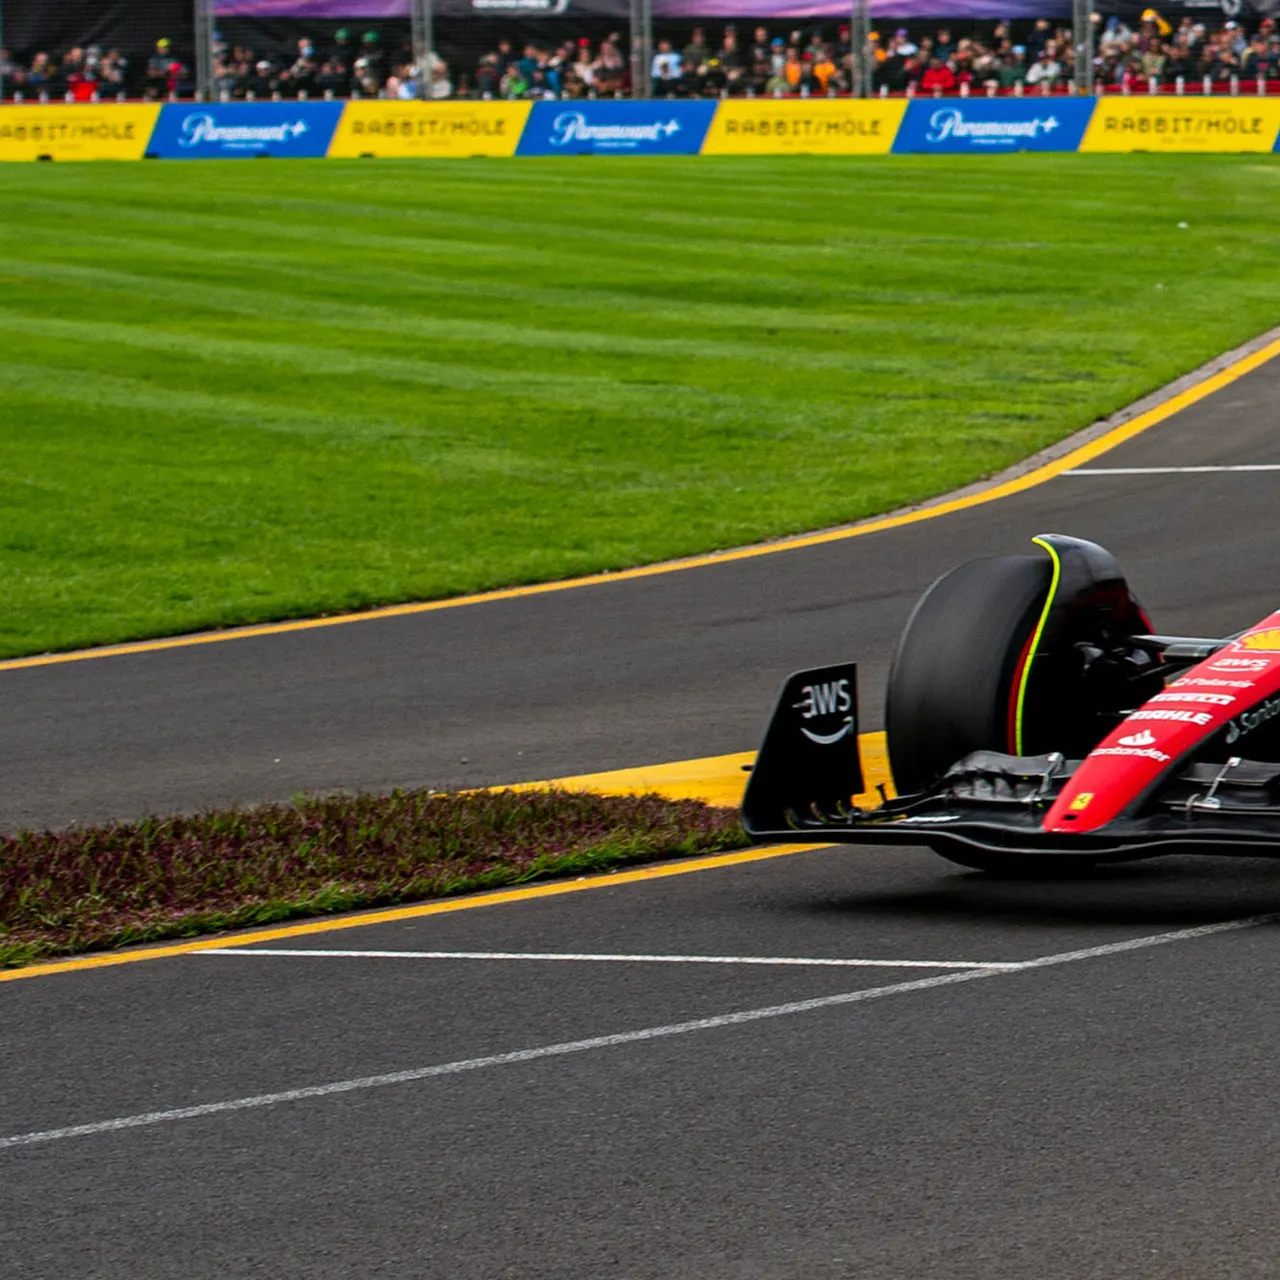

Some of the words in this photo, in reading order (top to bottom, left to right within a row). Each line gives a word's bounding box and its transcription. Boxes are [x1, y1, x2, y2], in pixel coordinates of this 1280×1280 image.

[178, 111, 308, 147] Paramount+
[550, 111, 681, 145] Paramount+
[926, 106, 1059, 142] Paramount+
[1213, 658, 1271, 667] aws
[792, 679, 852, 718] aws
